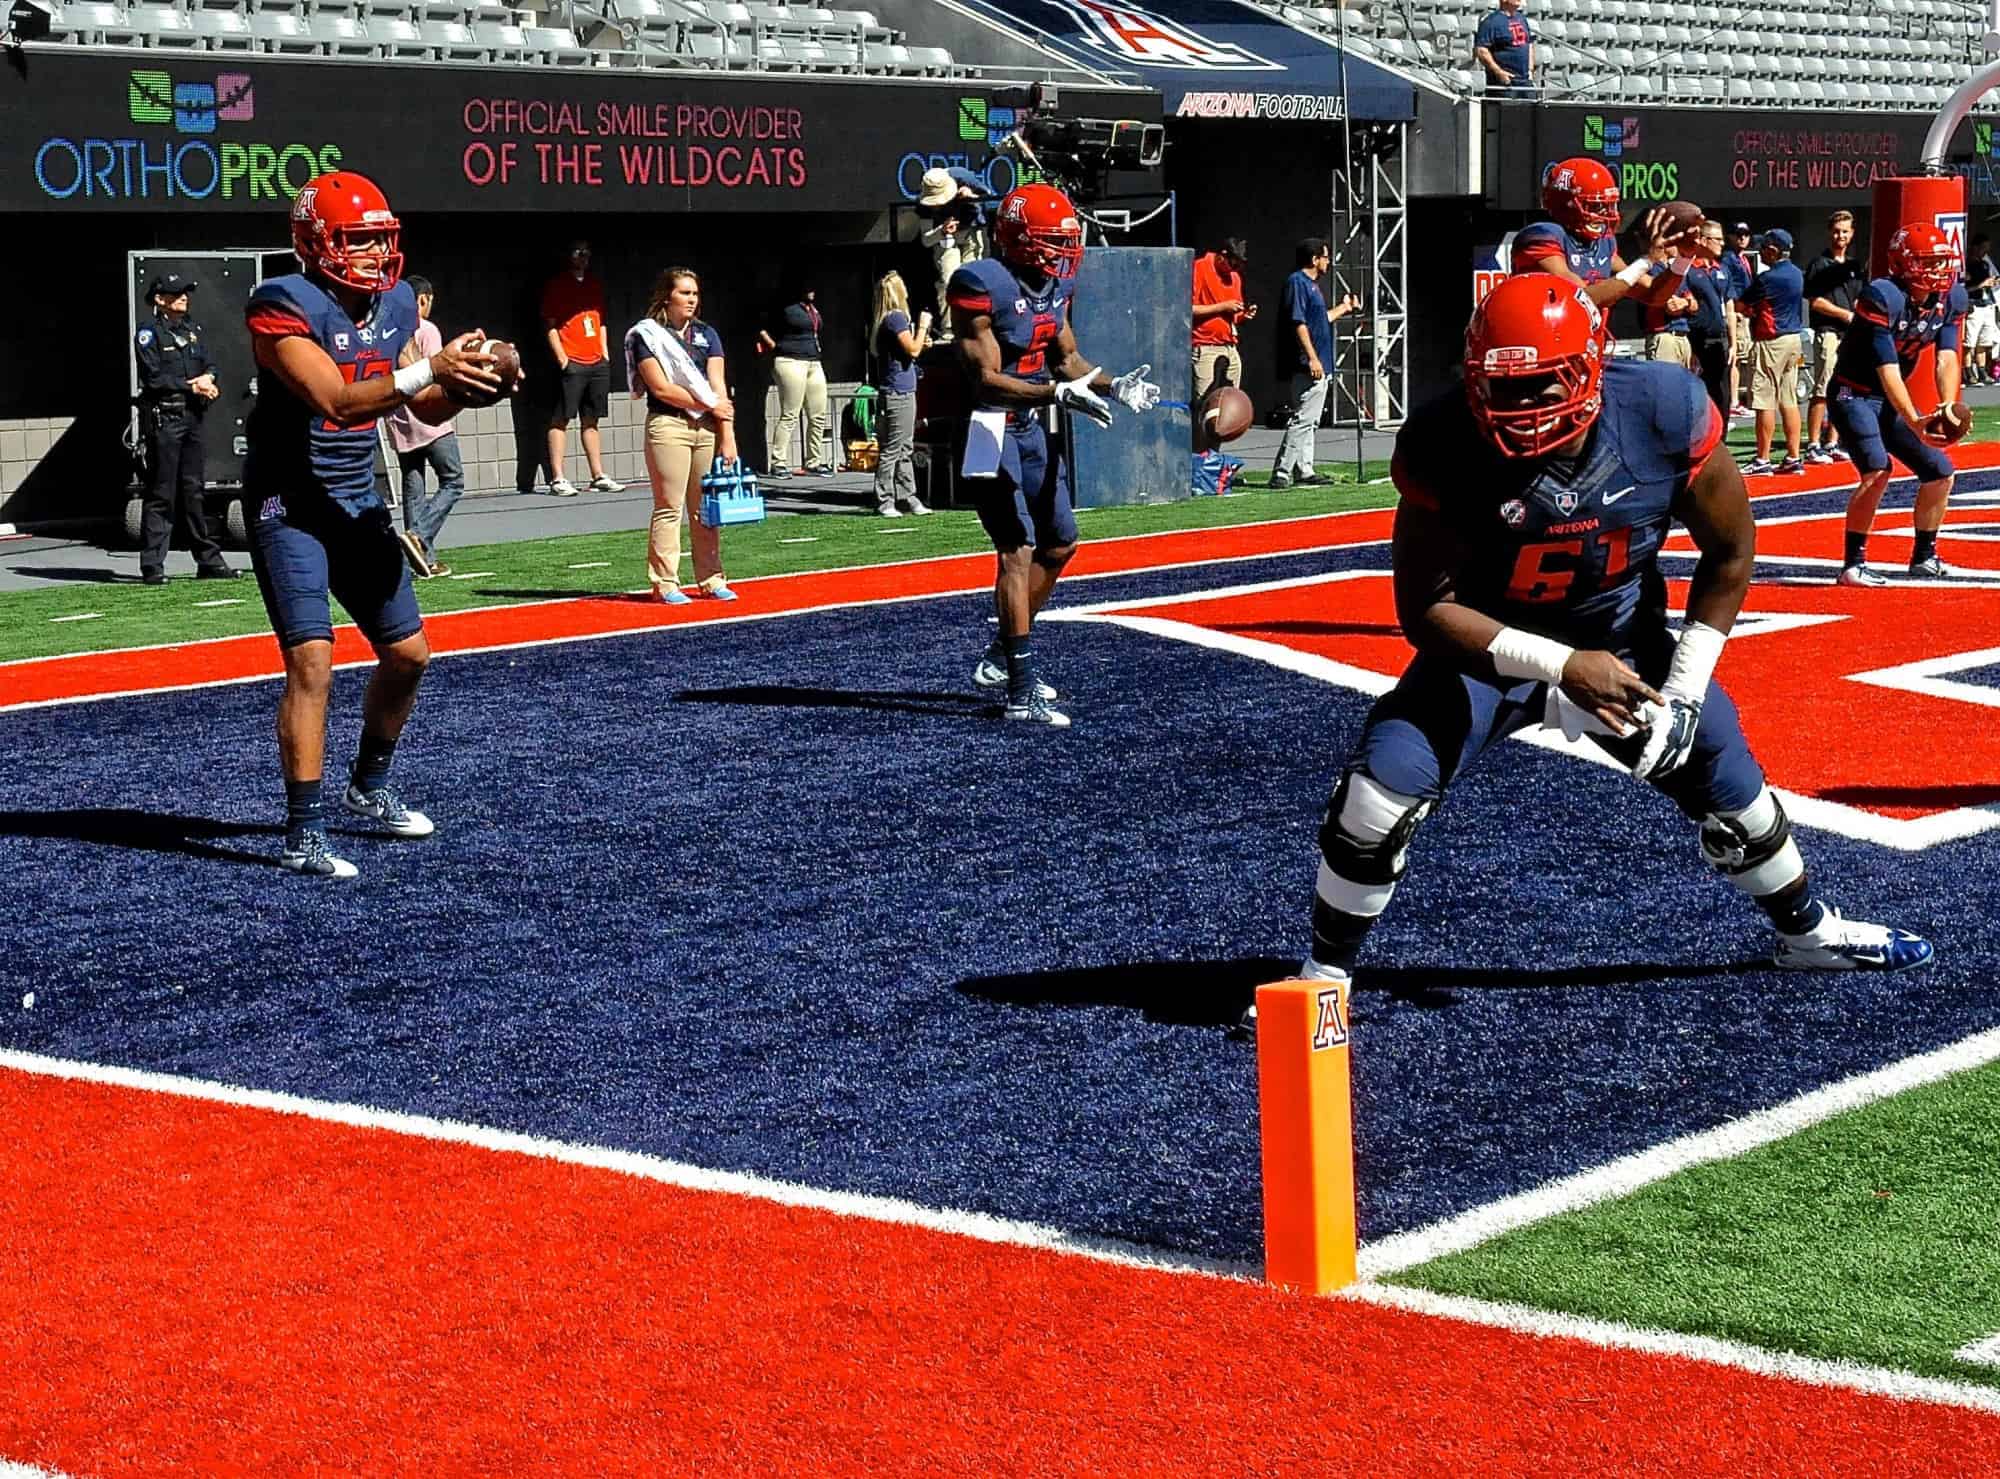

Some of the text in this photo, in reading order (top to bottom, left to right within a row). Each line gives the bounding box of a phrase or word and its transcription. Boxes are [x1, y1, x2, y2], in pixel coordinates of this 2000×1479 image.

[463, 99, 802, 139] OFFICIAL SMILE PROVIDER
[463, 142, 808, 188] OF THE WILDCATS
[1731, 160, 1759, 189] OF
[1766, 160, 1799, 189] THE
[1503, 524, 1633, 602] 61
[1312, 988, 1348, 1051] A
